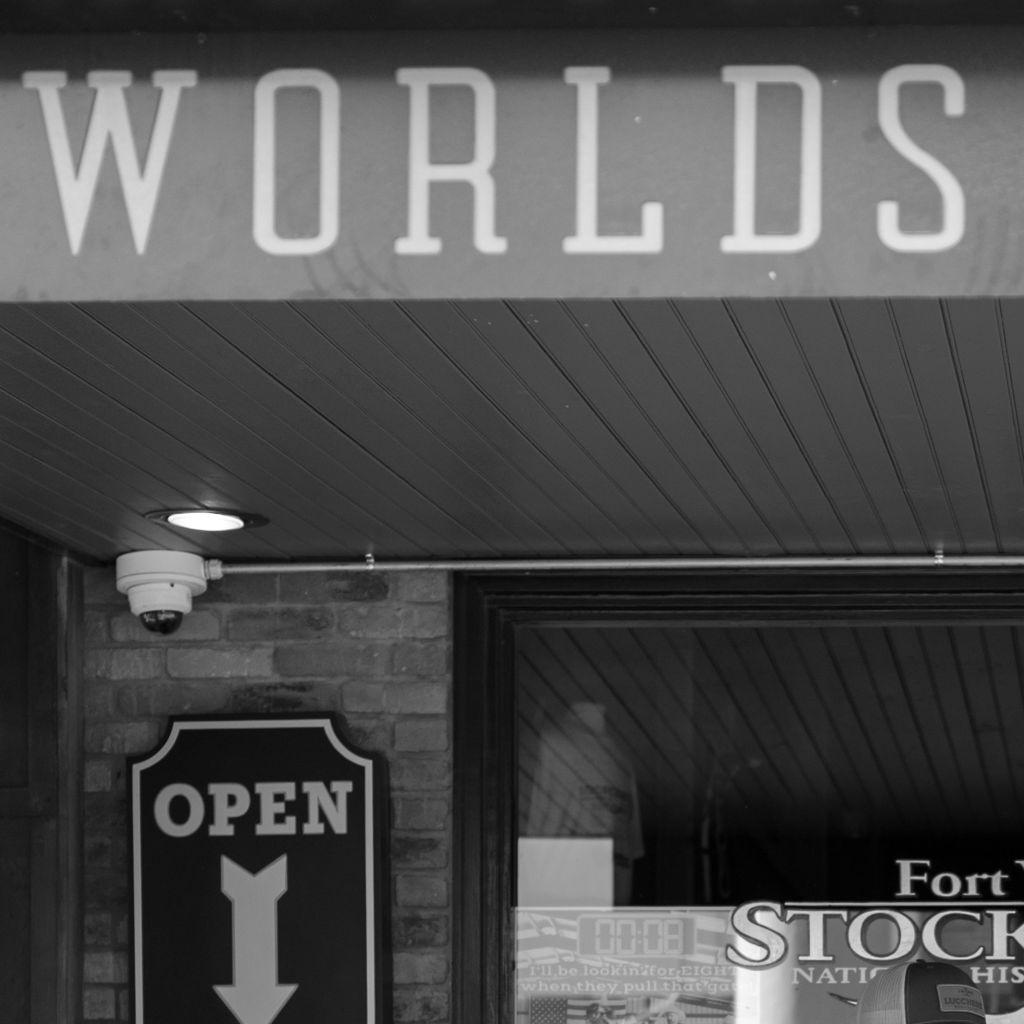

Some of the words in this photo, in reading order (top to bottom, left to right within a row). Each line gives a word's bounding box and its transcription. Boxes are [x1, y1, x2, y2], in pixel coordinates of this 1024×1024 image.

[22, 64, 966, 256] WORLDS
[154, 781, 353, 838] OPEN
[895, 858, 1009, 897] Fort
[530, 965, 552, 976] I'll
[556, 965, 577, 976] be
[649, 965, 676, 976] for
[791, 967, 889, 984] NATI
[522, 981, 576, 991] when
[577, 981, 618, 994] they
[624, 980, 657, 994] pull
[663, 980, 702, 992] that
